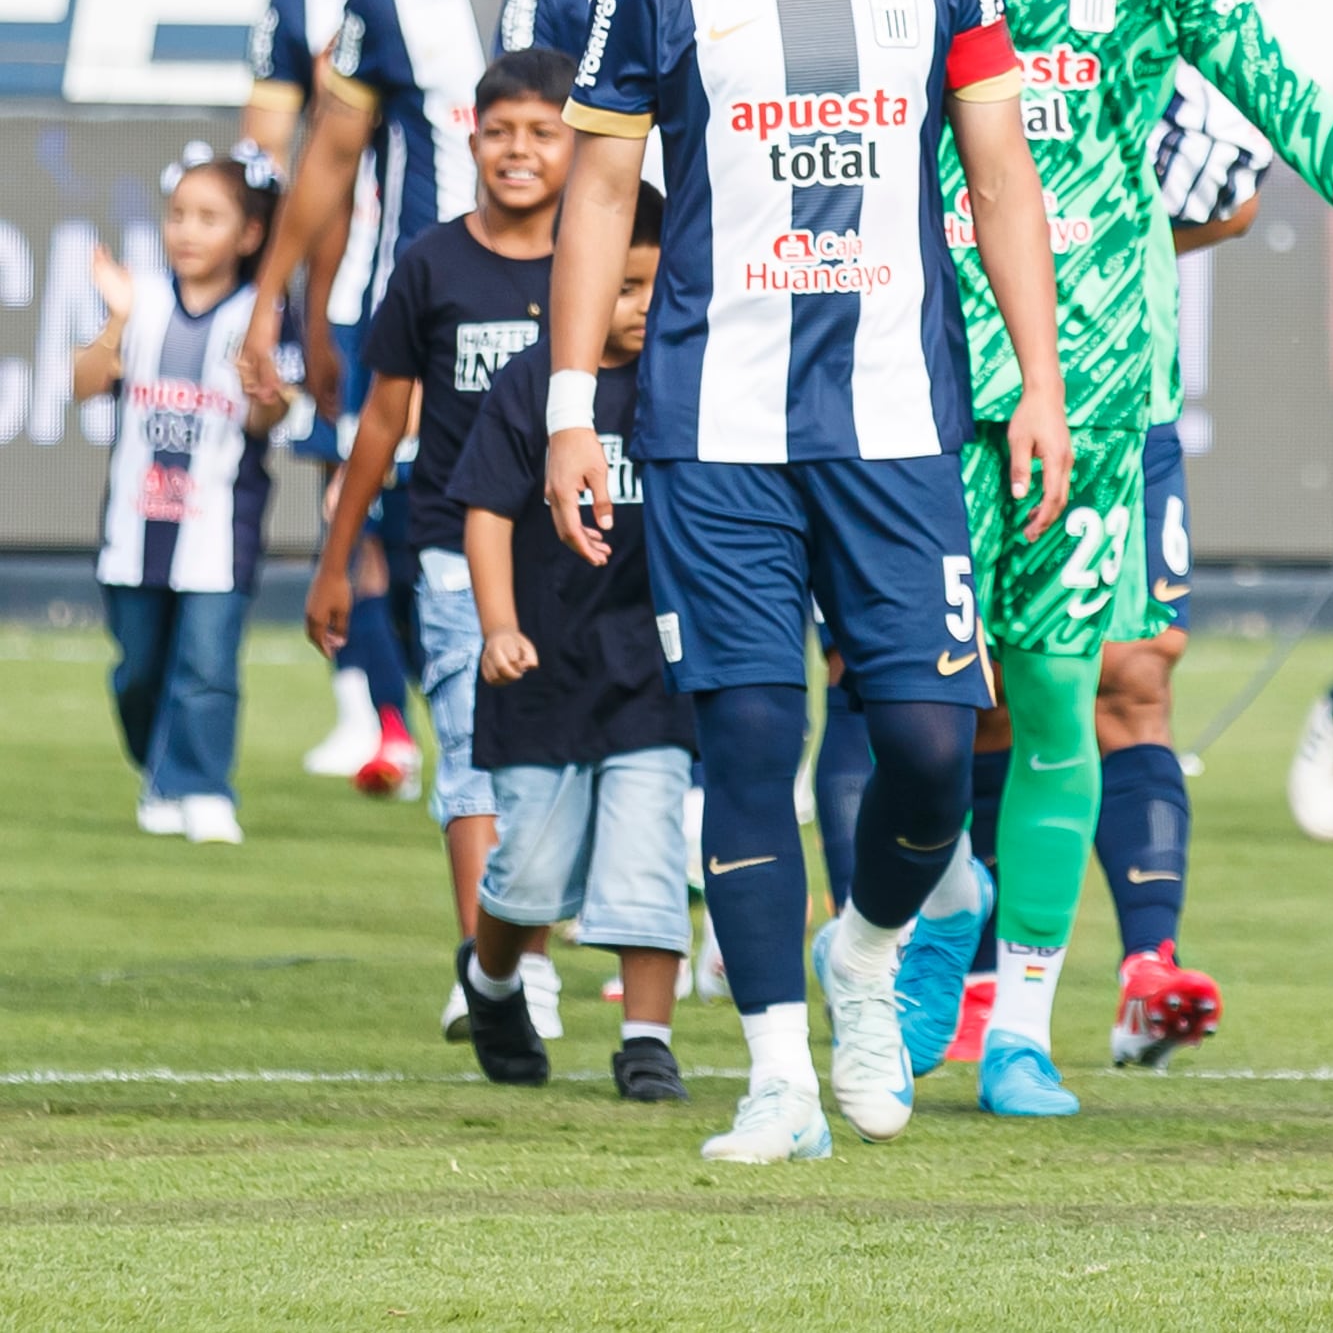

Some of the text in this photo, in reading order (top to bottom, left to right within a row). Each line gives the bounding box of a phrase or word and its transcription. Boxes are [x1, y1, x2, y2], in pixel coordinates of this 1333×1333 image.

[731, 89, 908, 141] apuesta
[769, 141, 880, 181] total
[818, 233, 863, 263] Caja
[746, 263, 891, 295] Huancayo
[1060, 506, 1130, 589] 23
[1161, 494, 1190, 577] 6
[942, 555, 975, 643] 5
